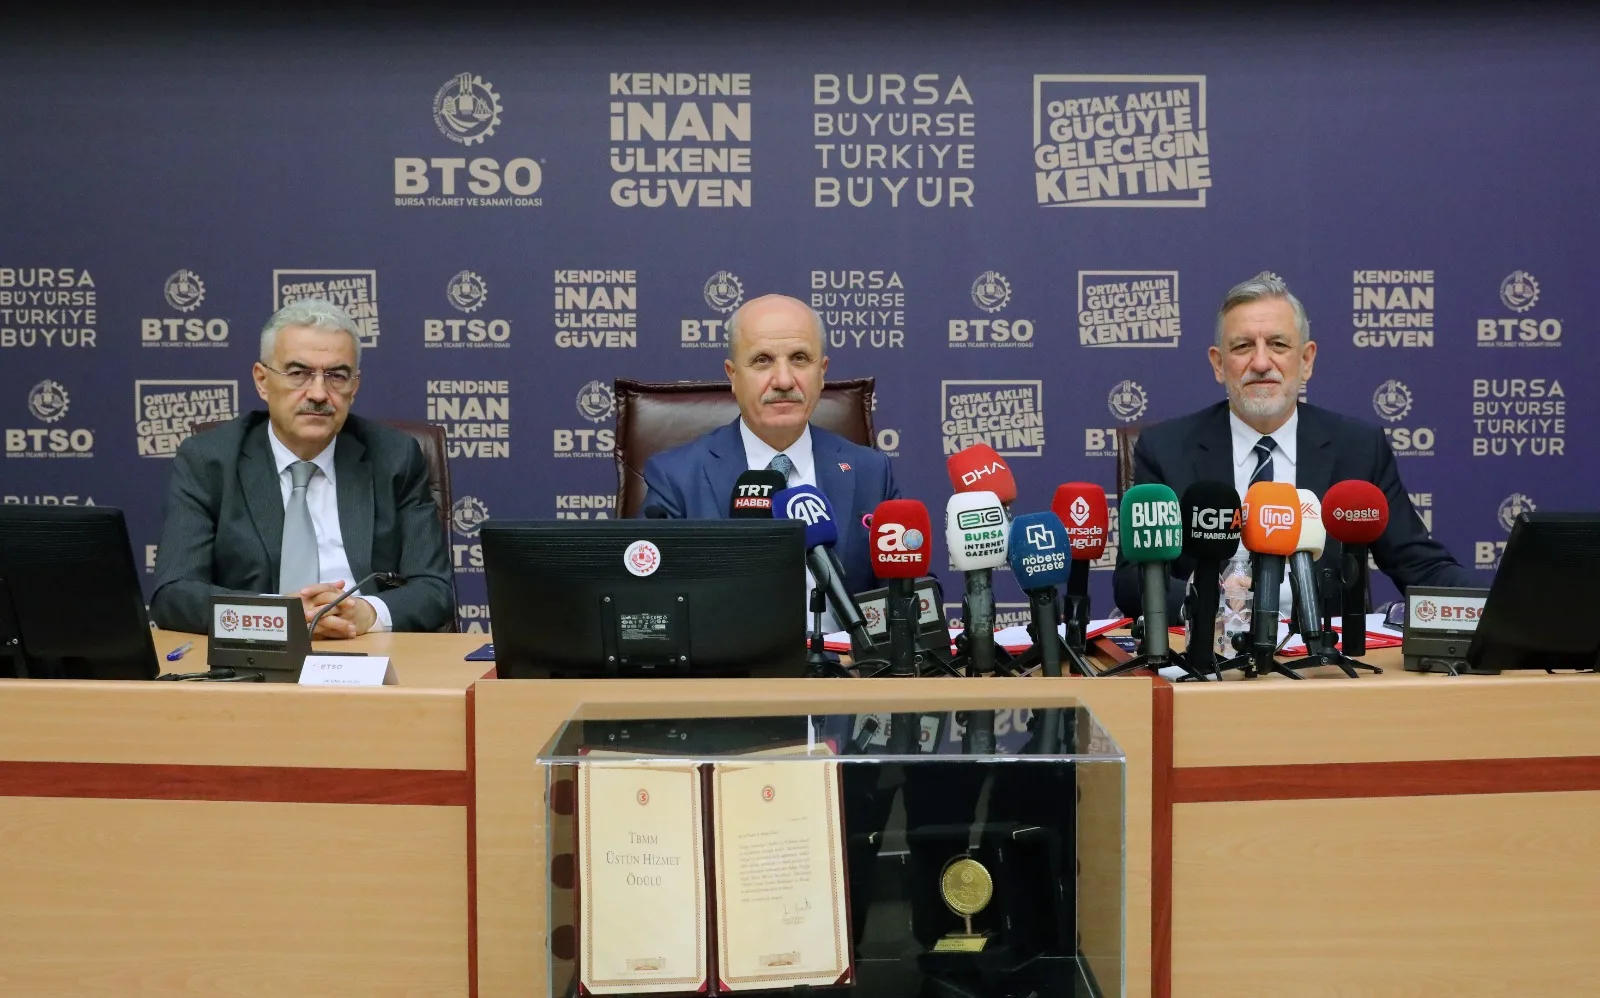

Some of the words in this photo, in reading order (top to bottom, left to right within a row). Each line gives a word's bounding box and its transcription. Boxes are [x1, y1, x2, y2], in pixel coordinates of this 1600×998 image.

[610, 73, 751, 95] KENDİNE
[814, 74, 974, 105] BURSA
[1047, 95, 1121, 118] ORTAK
[1125, 88, 1190, 111] AKLIN
[610, 102, 751, 141] İNAN
[814, 113, 975, 137] BÜYÜRSE
[610, 147, 751, 173] ÜLKENE
[815, 144, 975, 169] TÜRKİYE
[394, 157, 542, 195] BTSO
[610, 179, 751, 208] GÜVEN
[814, 177, 974, 208] BÜYÜR
[395, 197, 425, 206] BURSA
[427, 197, 464, 206] TİCARET
[466, 197, 478, 206] VE
[480, 197, 513, 206] SANAYİ
[515, 197, 542, 206] ODASI
[0, 268, 95, 287] BURSA
[554, 270, 636, 284] KENDİNE
[811, 270, 904, 289] BURSA
[1353, 270, 1434, 284] KENDİNE
[281, 281, 325, 295] ORTAK
[328, 278, 366, 291] AKLIN
[1086, 282, 1129, 296] ORTAK
[1131, 278, 1169, 292] AKLIN
[0, 291, 96, 306] BÜYÜRSE
[554, 286, 637, 310] İNAN
[811, 293, 904, 307] BÜYÜRSE
[1353, 287, 1434, 310] İNAN
[1, 309, 96, 325] TÜRKİYE
[554, 313, 636, 328] ÜLKENE
[1353, 313, 1434, 328] ÜLKENE
[1, 329, 96, 347] BÜYÜR
[141, 318, 229, 341] BTSO
[424, 319, 510, 341] BTSO
[681, 320, 730, 341] BT
[949, 319, 1034, 341] BTSO
[1477, 319, 1562, 341] BTSO
[554, 331, 637, 348] GÜVEN
[830, 330, 904, 348] ÜYÜR
[1353, 331, 1434, 347] GÜVEN
[427, 380, 508, 394] KENDİNE
[1473, 379, 1565, 398] BURSA
[143, 392, 187, 405] ORTAK
[190, 388, 228, 402] AKLIN
[949, 392, 991, 405] ORTAK
[995, 388, 1033, 402] AKLIN
[427, 397, 509, 420] İNAN
[1473, 401, 1565, 416] BÜYÜRSE
[432, 423, 509, 438] LKENE
[1473, 419, 1565, 434] TÜRKİYE
[5, 428, 93, 452] BTSO
[554, 429, 616, 451] BTS
[1473, 438, 1565, 456] BÜYÜR
[447, 441, 509, 458] ÜVEN
[961, 461, 1005, 486] DHA
[738, 484, 773, 497] TRT
[735, 498, 770, 508] HABER
[794, 499, 831, 527] AA
[1264, 508, 1291, 525] line
[964, 530, 1004, 542] BURSA
[1065, 525, 1103, 535] ursada
[1068, 535, 1102, 550] ugün
[878, 553, 922, 563] GAZETE
[1025, 560, 1065, 577] gazete
[242, 615, 285, 629] BTSO
[995, 610, 1032, 624] AKLIN
[628, 831, 658, 844] TBMM
